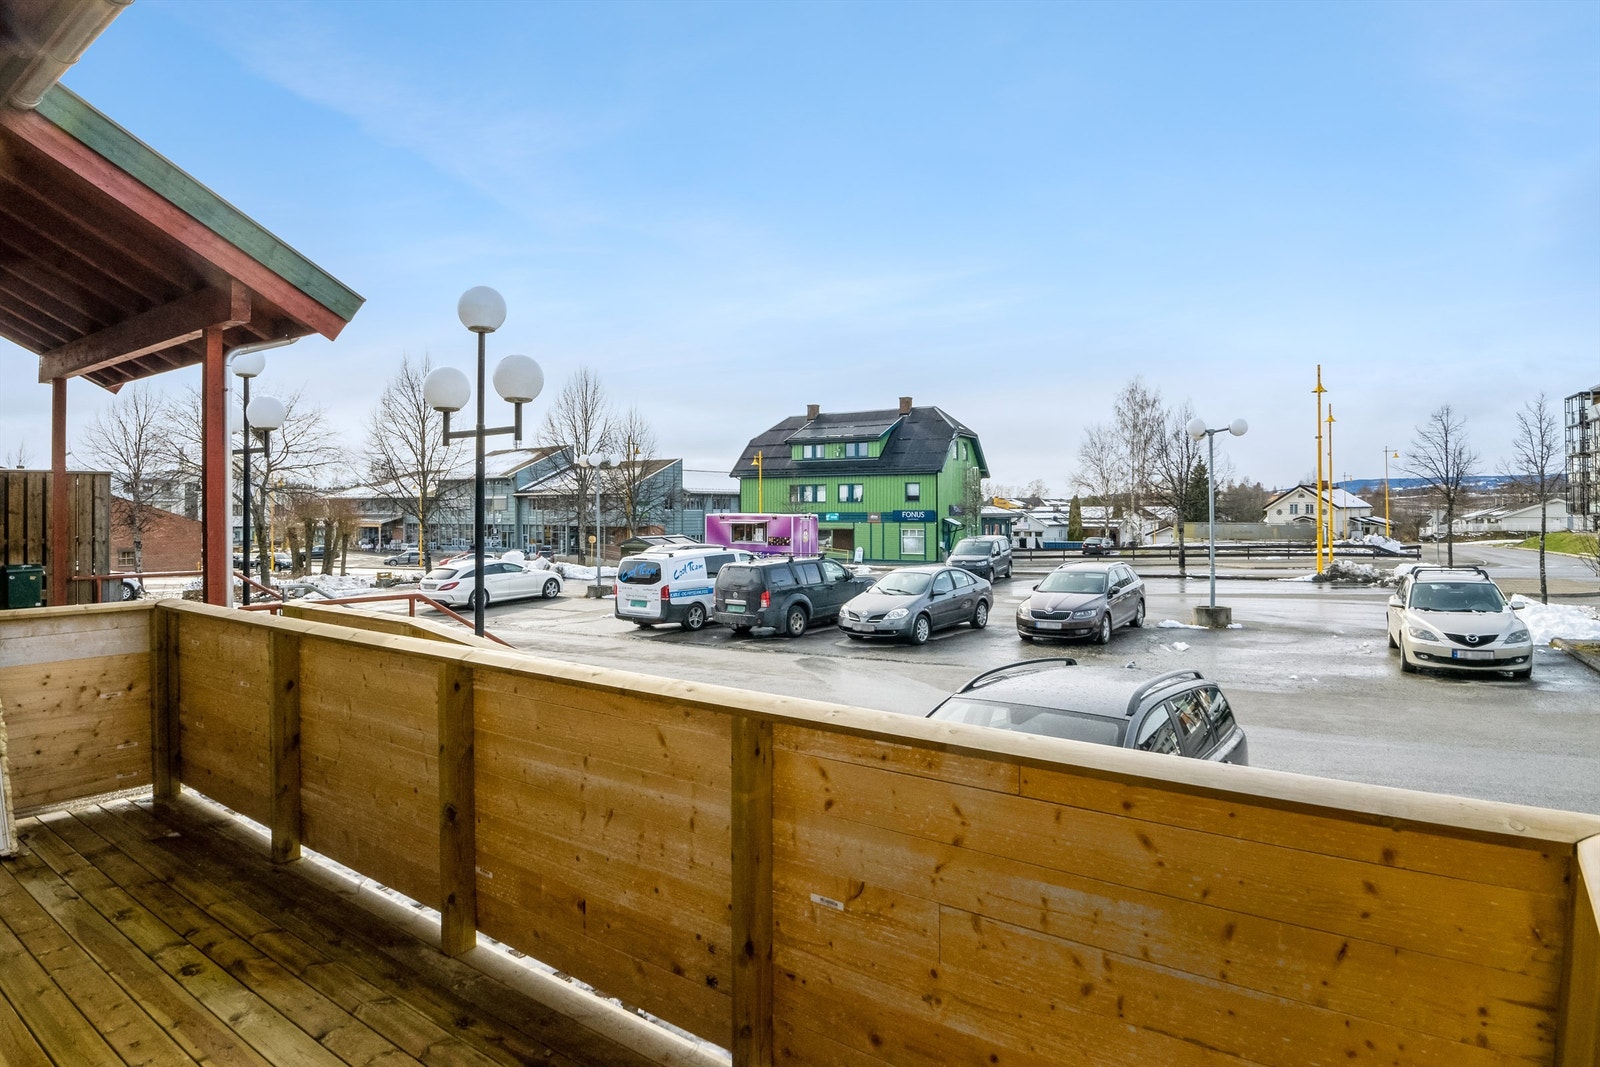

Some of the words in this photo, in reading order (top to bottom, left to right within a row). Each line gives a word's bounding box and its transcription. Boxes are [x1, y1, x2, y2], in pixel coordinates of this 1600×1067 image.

[621, 565, 638, 581] Cool
[638, 563, 657, 575] Team
[674, 563, 687, 580] Cool
[688, 561, 704, 571] Team
